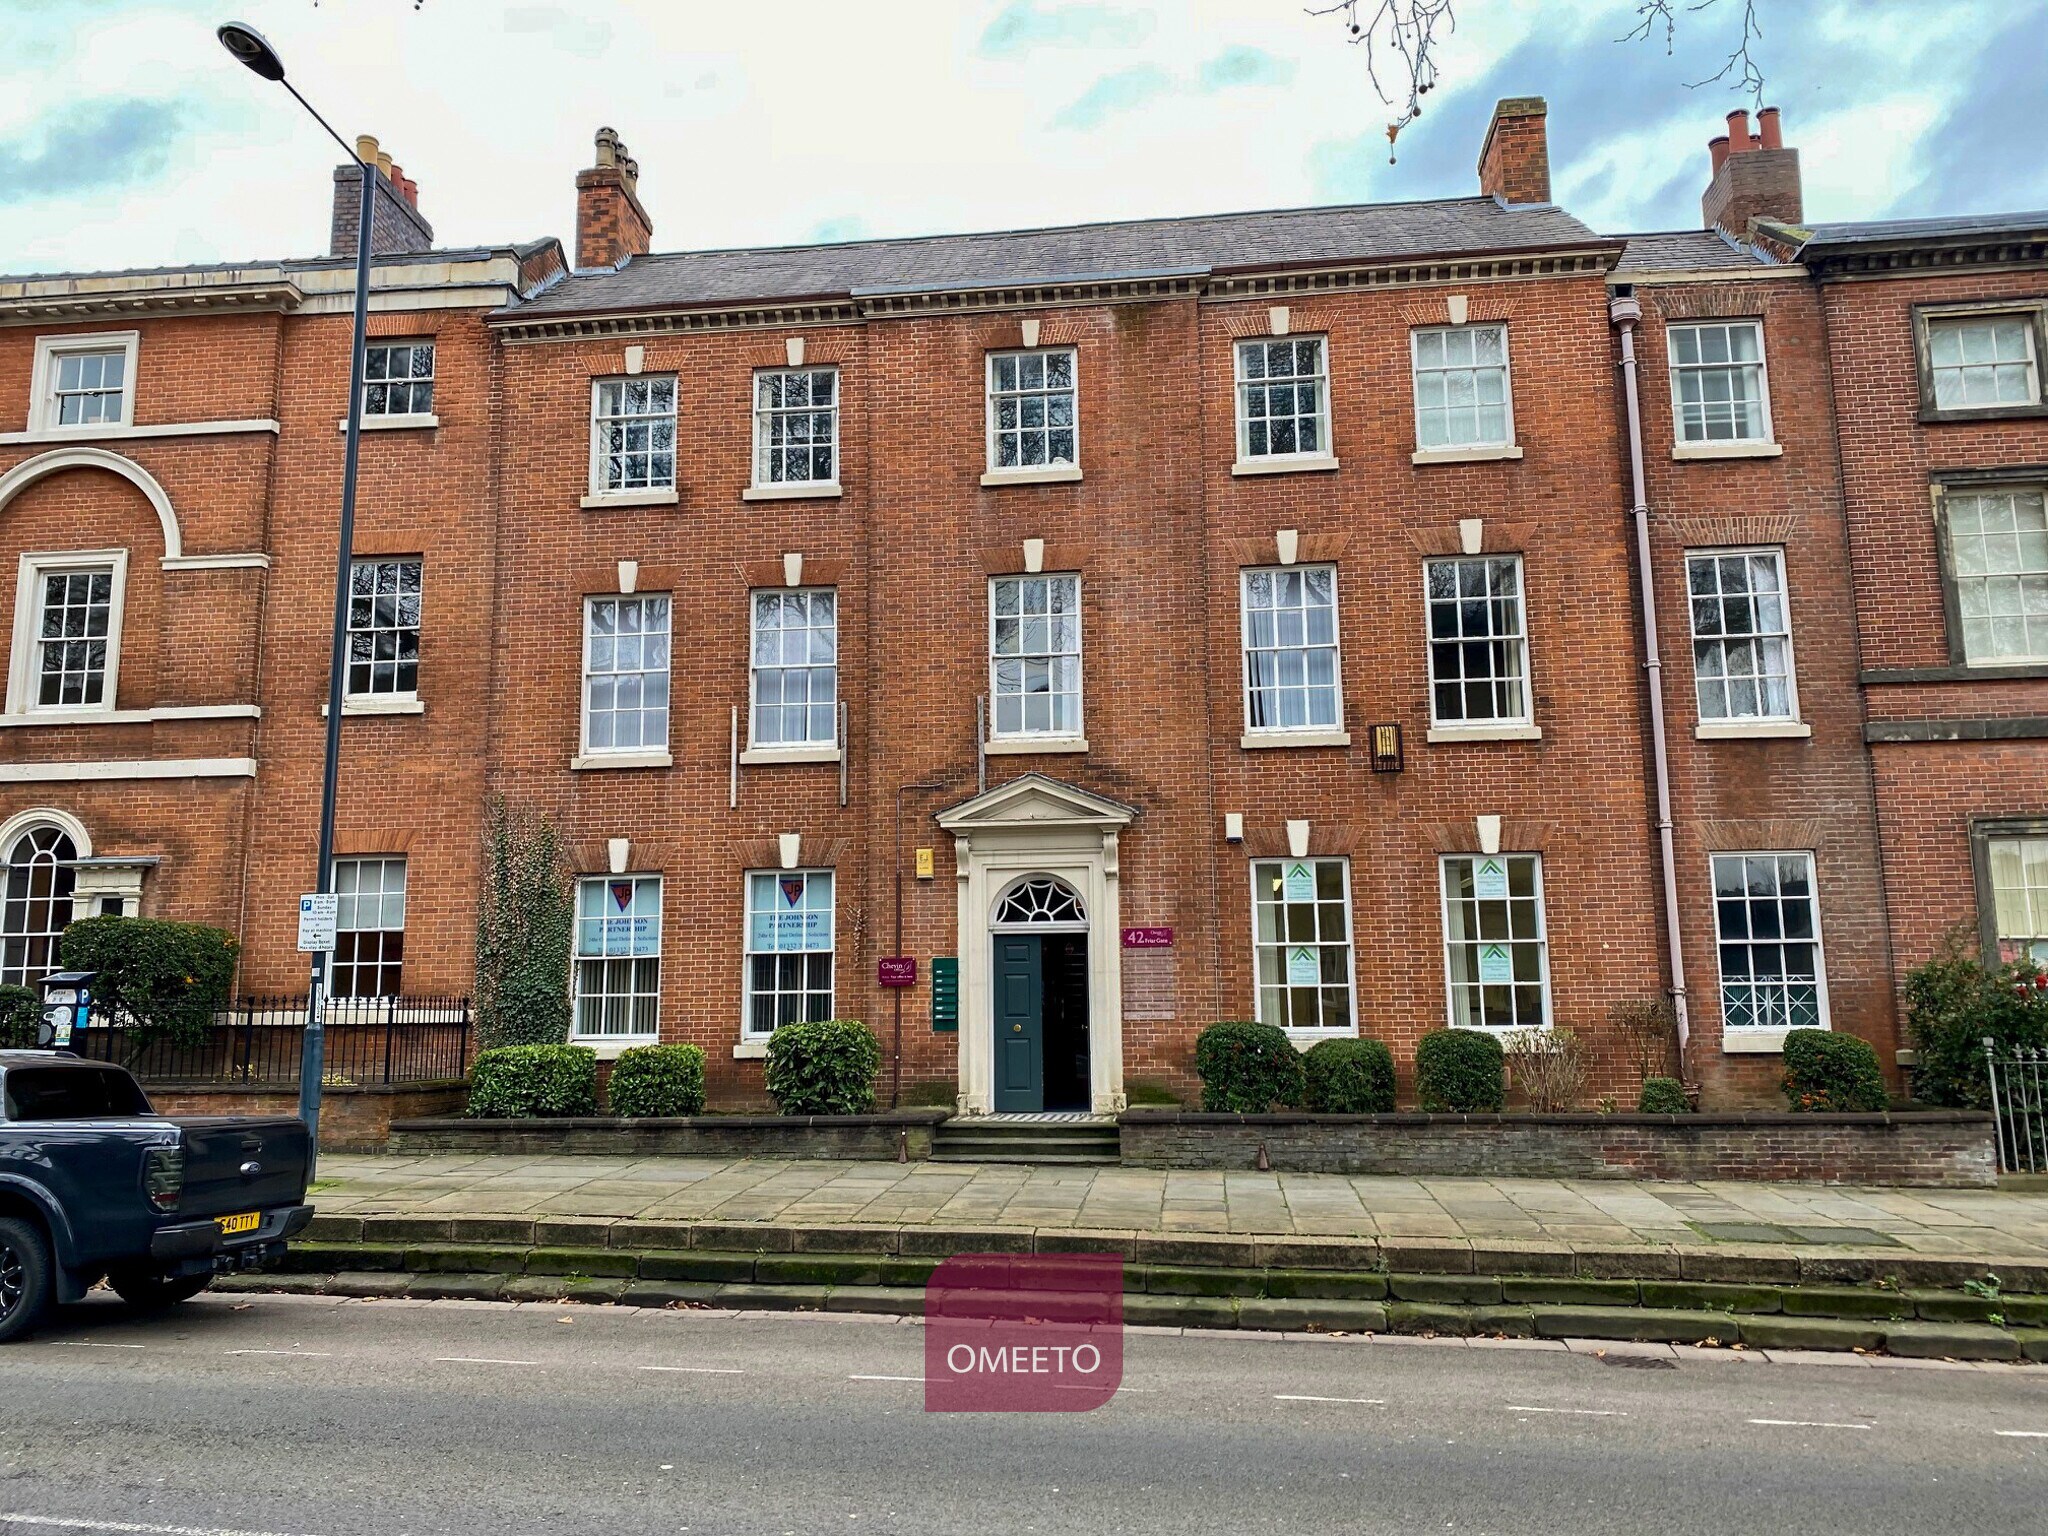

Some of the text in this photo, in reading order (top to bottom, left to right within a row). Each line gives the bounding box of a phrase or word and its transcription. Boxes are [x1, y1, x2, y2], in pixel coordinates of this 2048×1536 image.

[786, 884, 801, 896] JP
[303, 901, 310, 910] P
[1127, 931, 1144, 944] 42
[81, 988, 89, 1004] P
[240, 1214, 255, 1229] TTY
